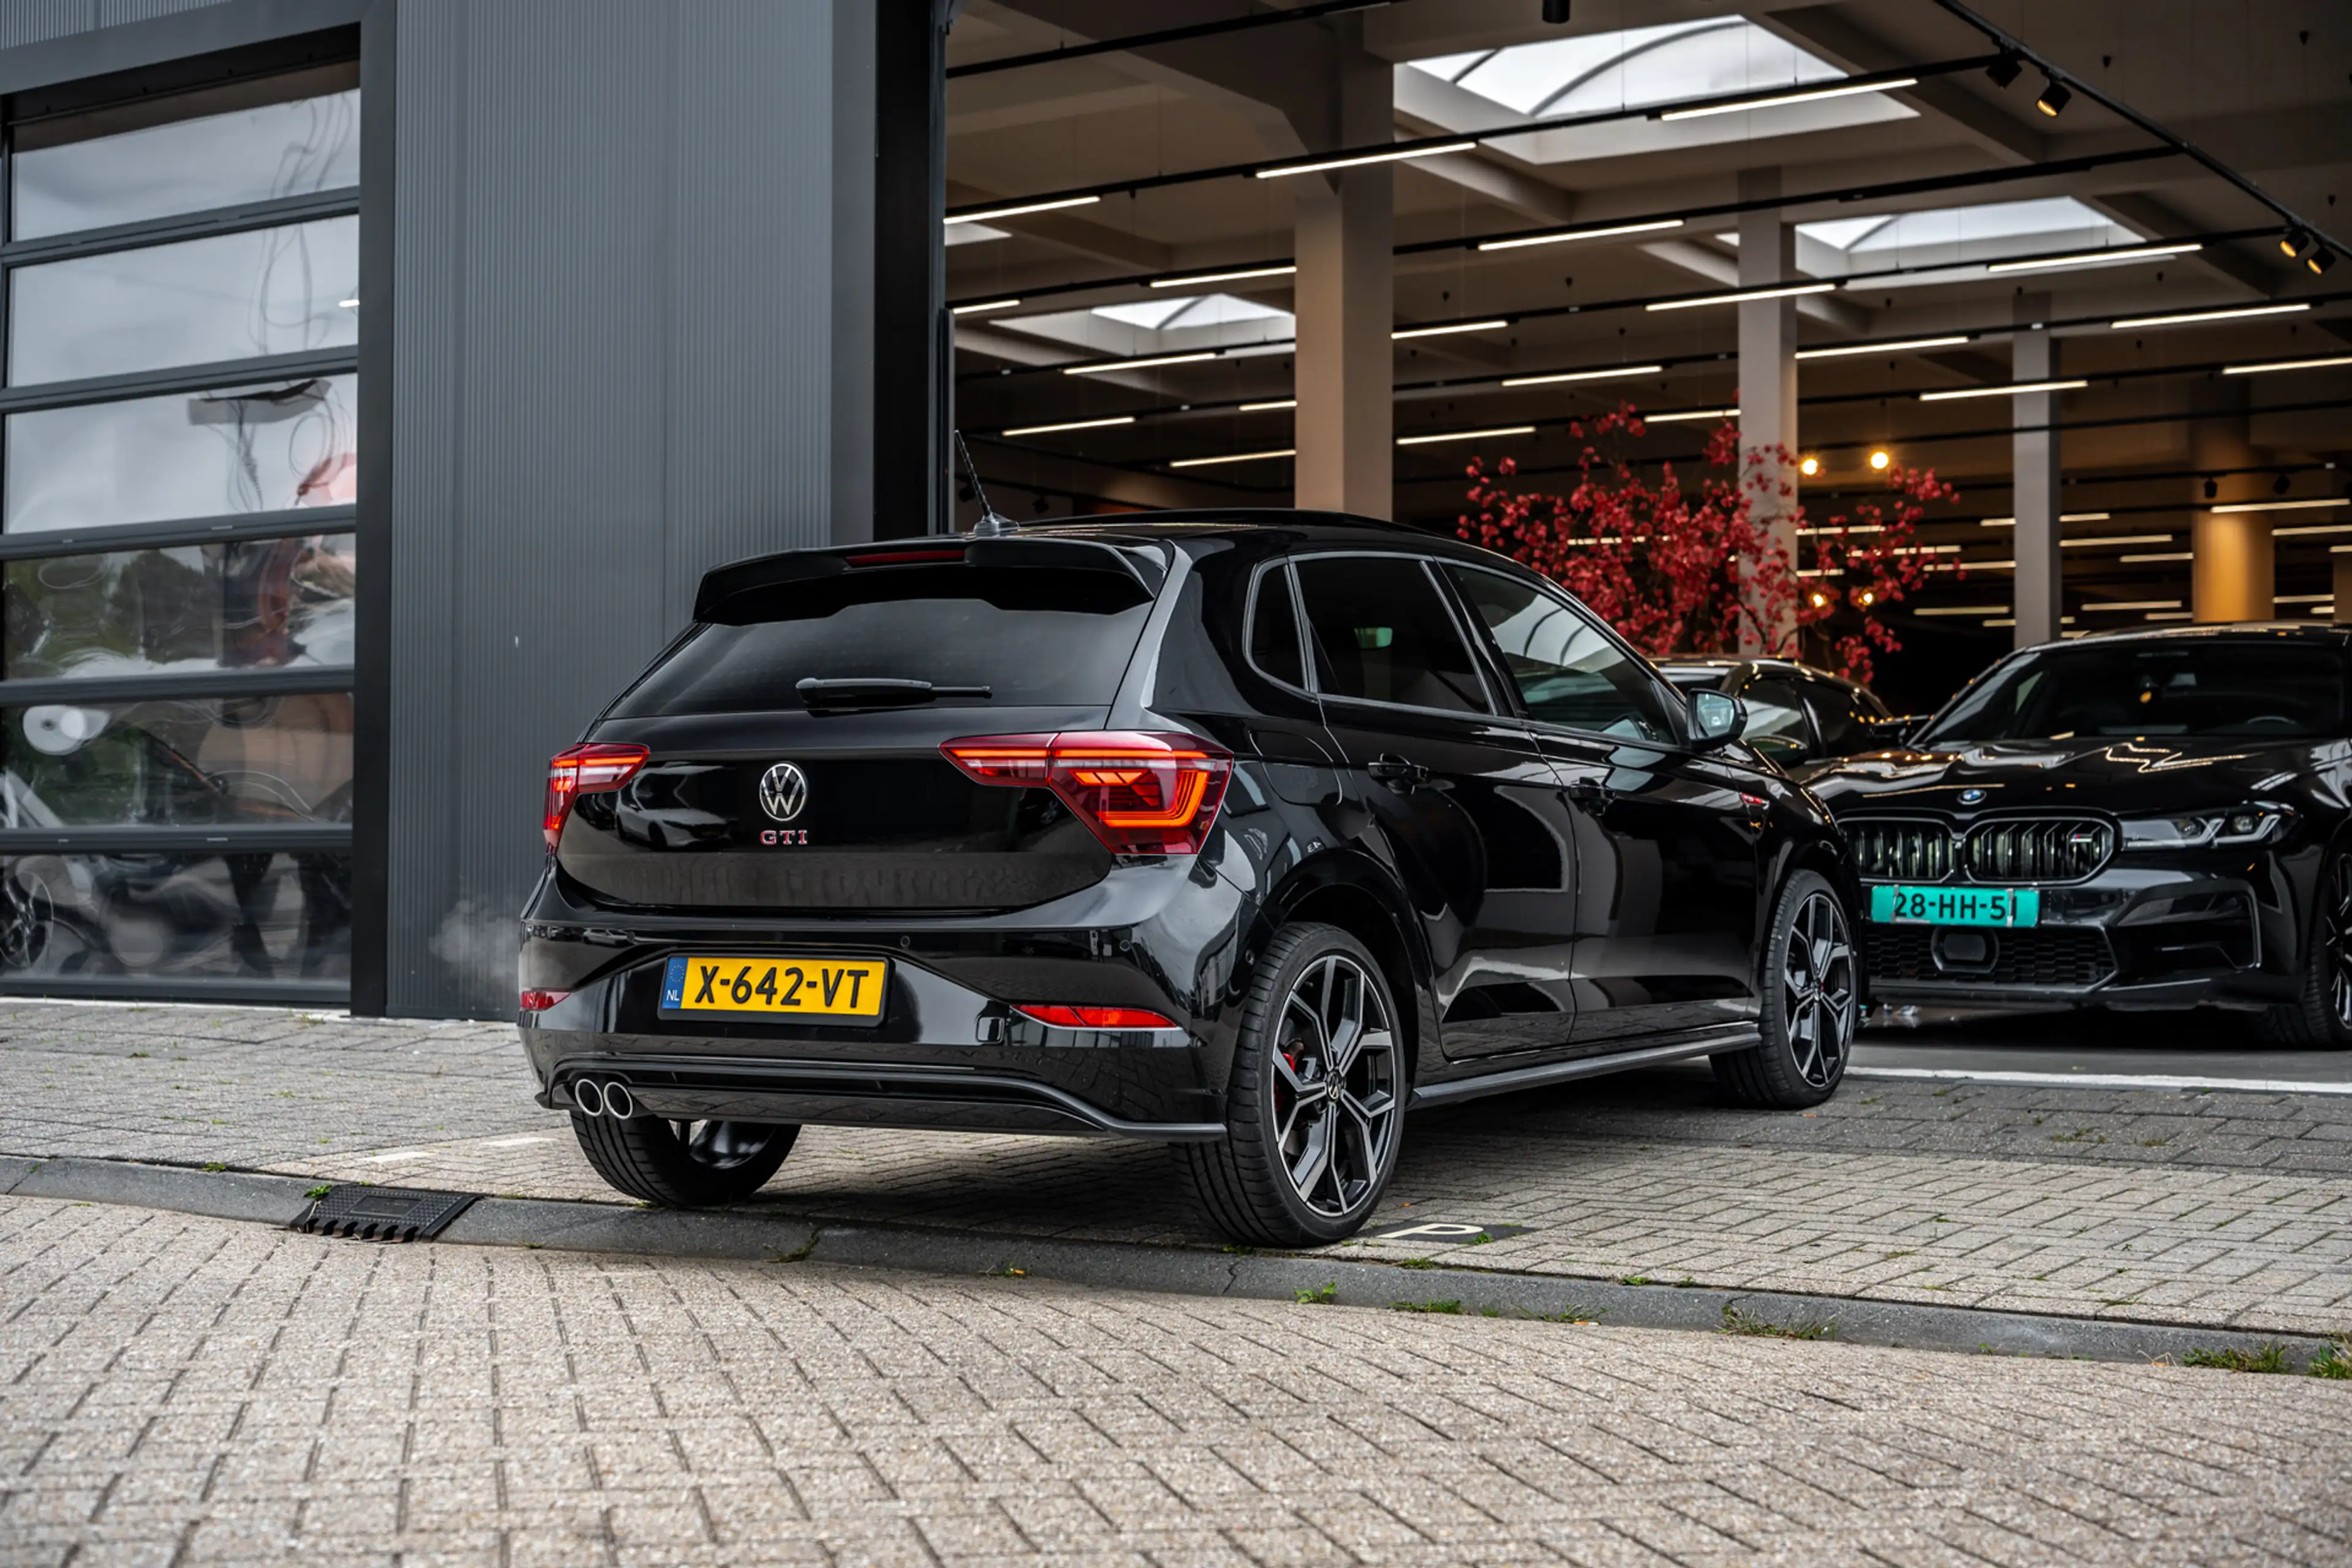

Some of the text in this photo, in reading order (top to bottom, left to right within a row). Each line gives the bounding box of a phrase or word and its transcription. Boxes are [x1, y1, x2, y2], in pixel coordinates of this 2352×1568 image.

[760, 830, 807, 845] GTI
[695, 966, 869, 1008] X-642-VT
[666, 989, 680, 1001] NL
[1376, 1223, 1483, 1238] P
